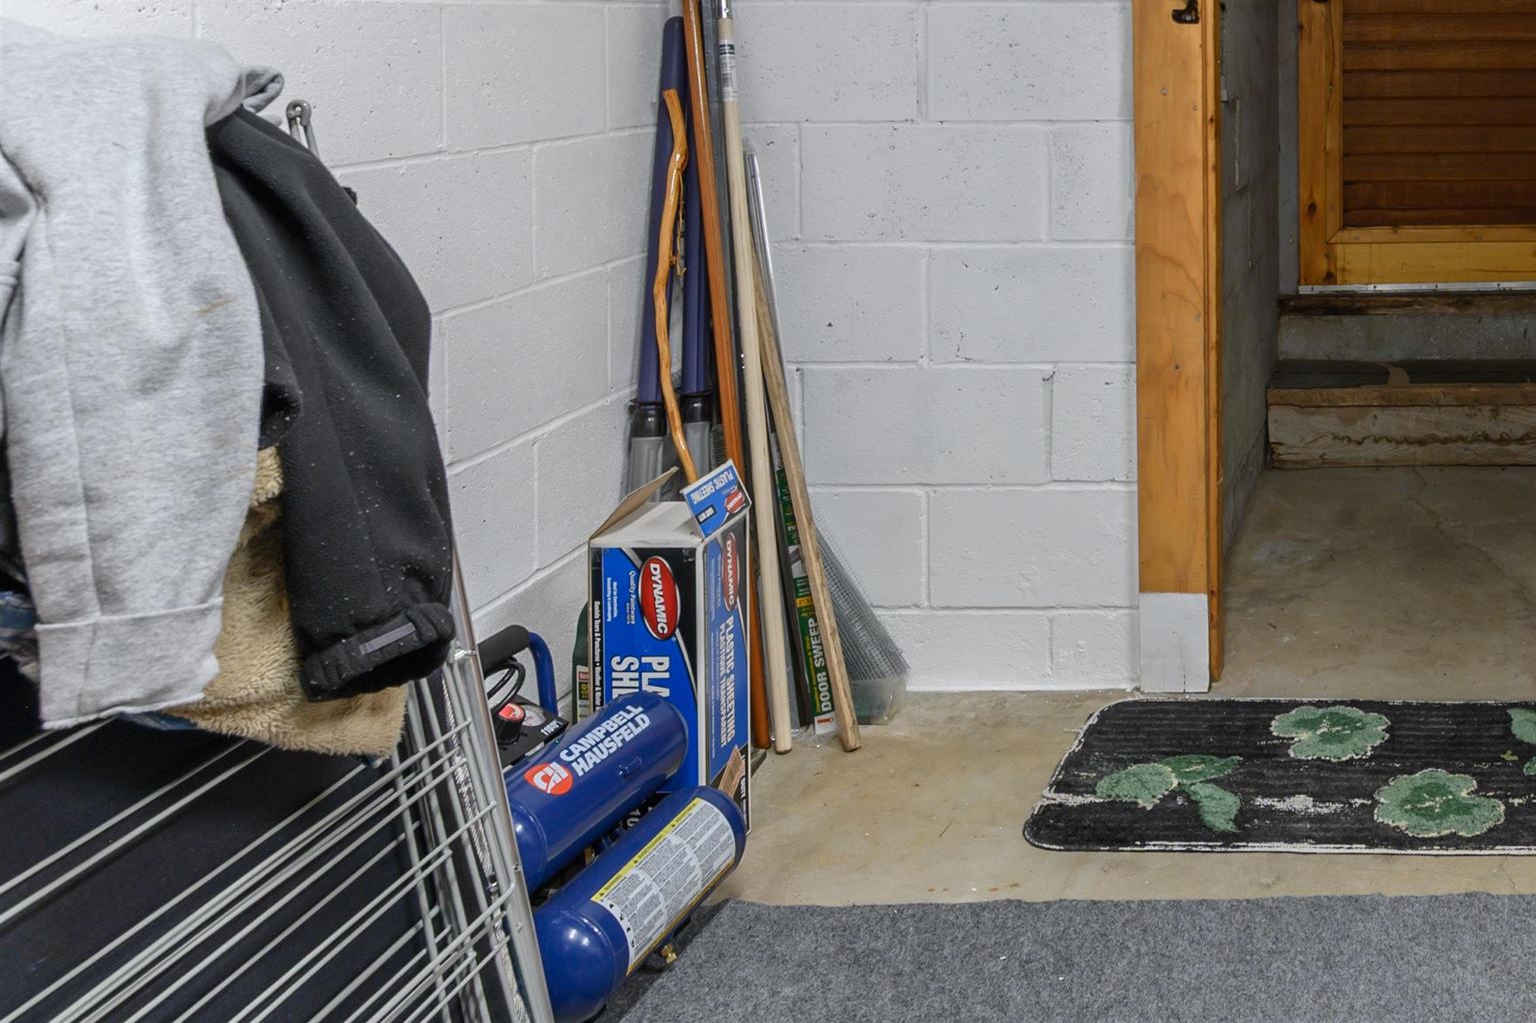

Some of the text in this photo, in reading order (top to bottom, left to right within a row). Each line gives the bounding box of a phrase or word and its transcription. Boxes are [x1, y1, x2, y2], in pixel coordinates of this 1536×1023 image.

[650, 562, 668, 635] DYNAMIC
[726, 540, 735, 605] DYNAMIC
[808, 617, 825, 668] SWEEP
[641, 656, 670, 697] PLA
[726, 615, 736, 743] PLASTIC SHEETING
[816, 671, 833, 713] DOOR
[559, 704, 644, 762] CAMPBELL
[570, 713, 651, 777] HAUSFELD
